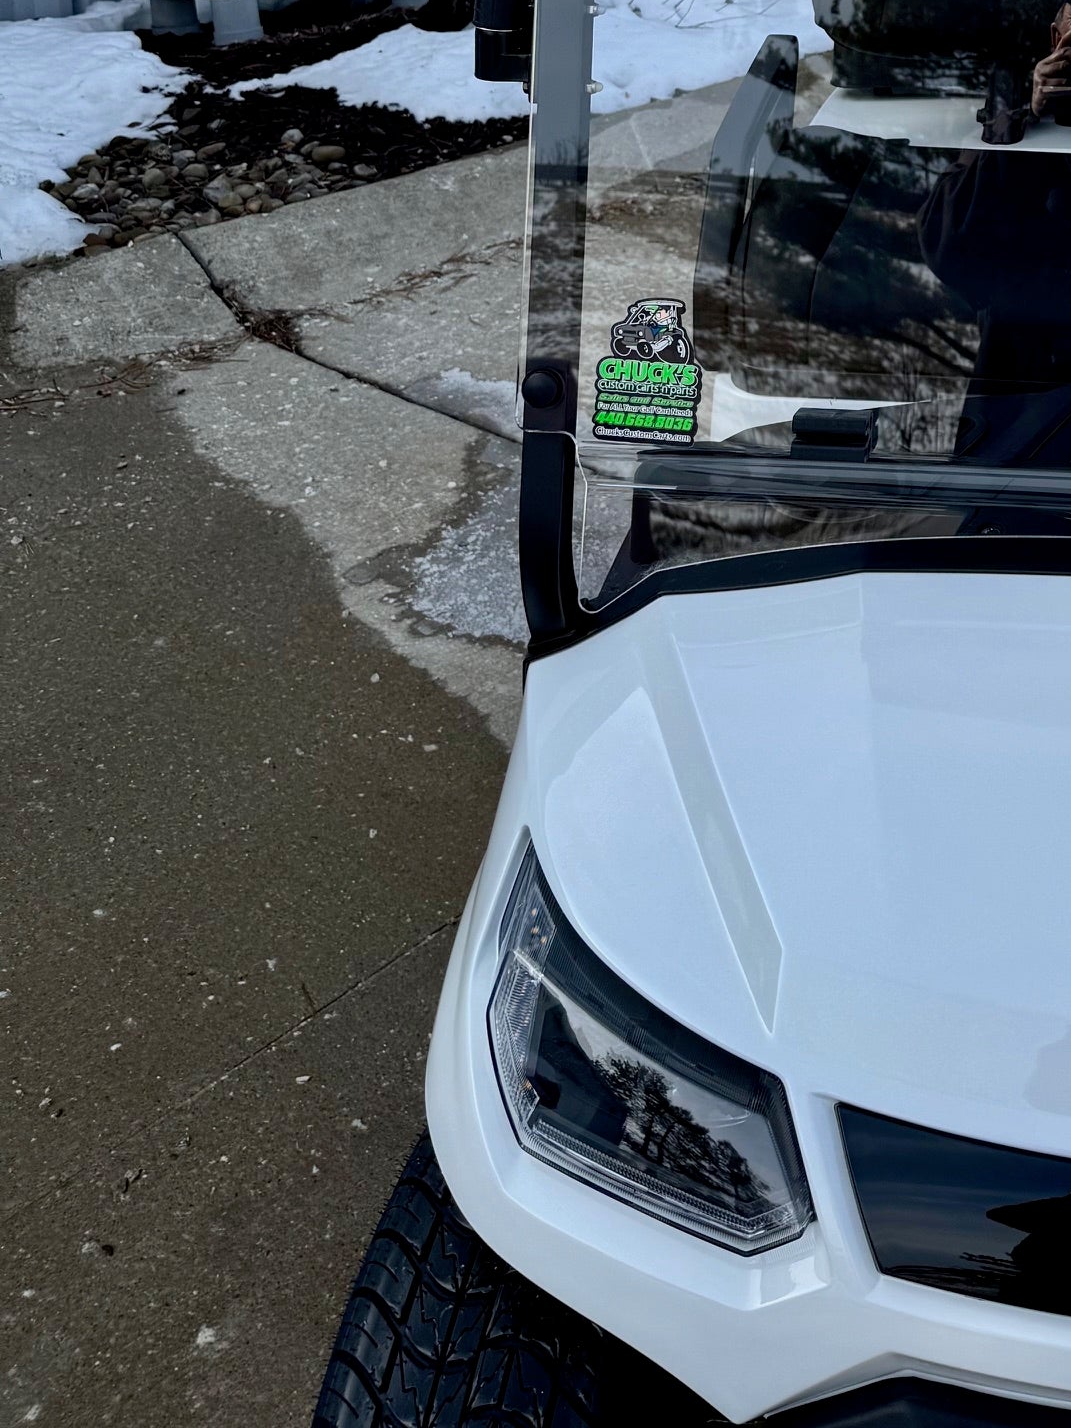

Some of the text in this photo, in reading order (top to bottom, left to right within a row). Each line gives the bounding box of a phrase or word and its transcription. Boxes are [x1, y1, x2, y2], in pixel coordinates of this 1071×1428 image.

[599, 358, 696, 386] CHUCK'S
[599, 380, 634, 391] custom
[596, 412, 694, 431] 440.668.8036
[595, 426, 692, 443] ChucksCustomCarts.com
